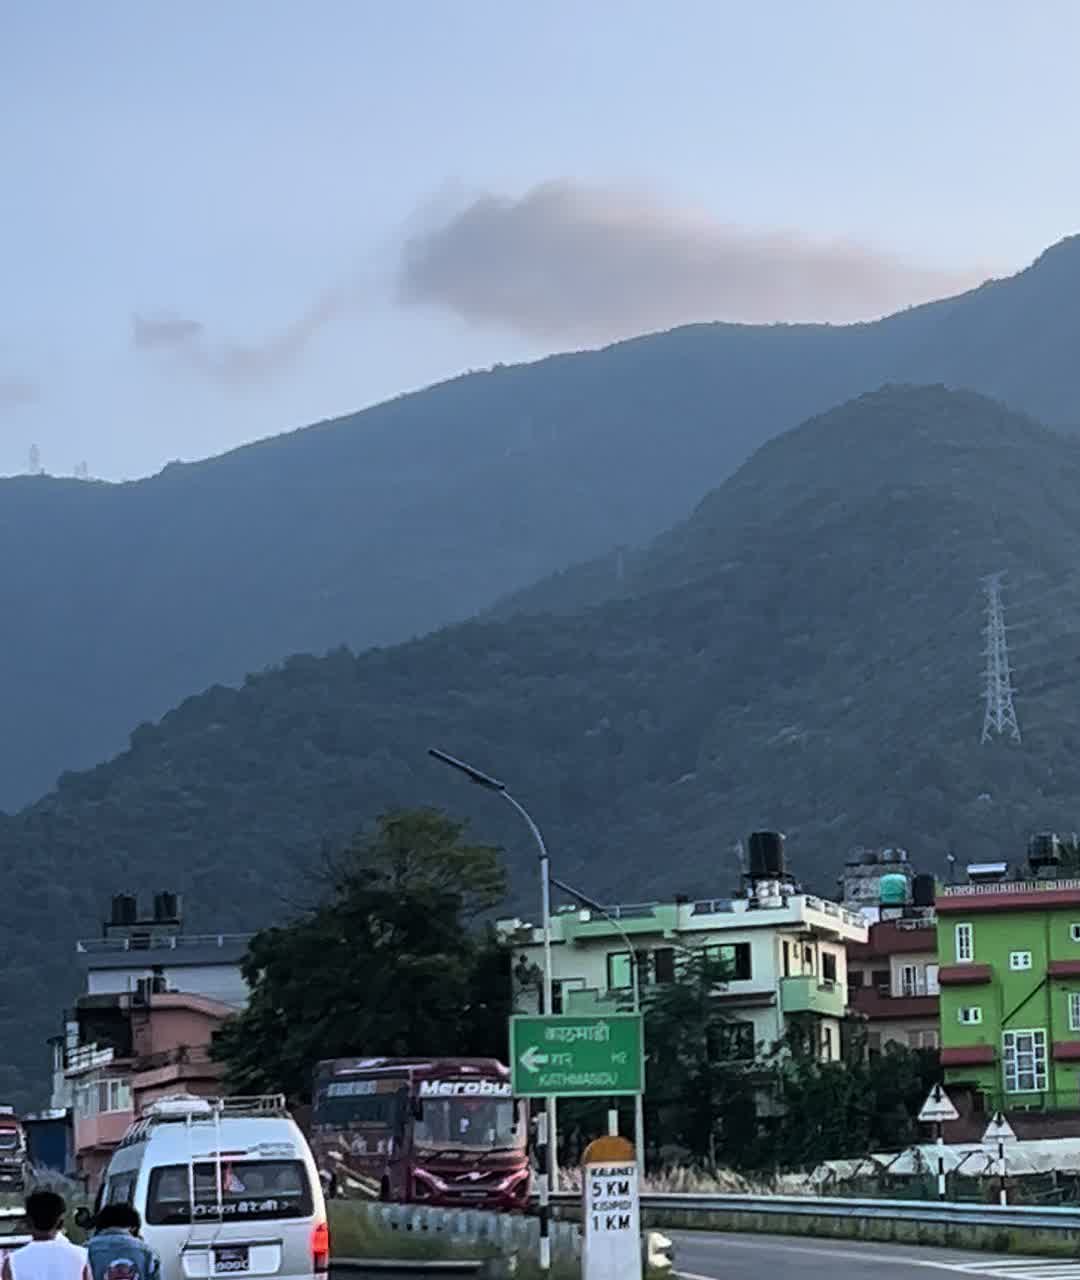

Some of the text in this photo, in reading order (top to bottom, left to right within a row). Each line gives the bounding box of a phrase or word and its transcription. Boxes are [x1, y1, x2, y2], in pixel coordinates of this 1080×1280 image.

[538, 1071, 619, 1087] KATHMANDU
[420, 1080, 512, 1096] Merobu
[592, 1181, 629, 1197] 5 KM
[592, 1215, 630, 1232] 1 KM
